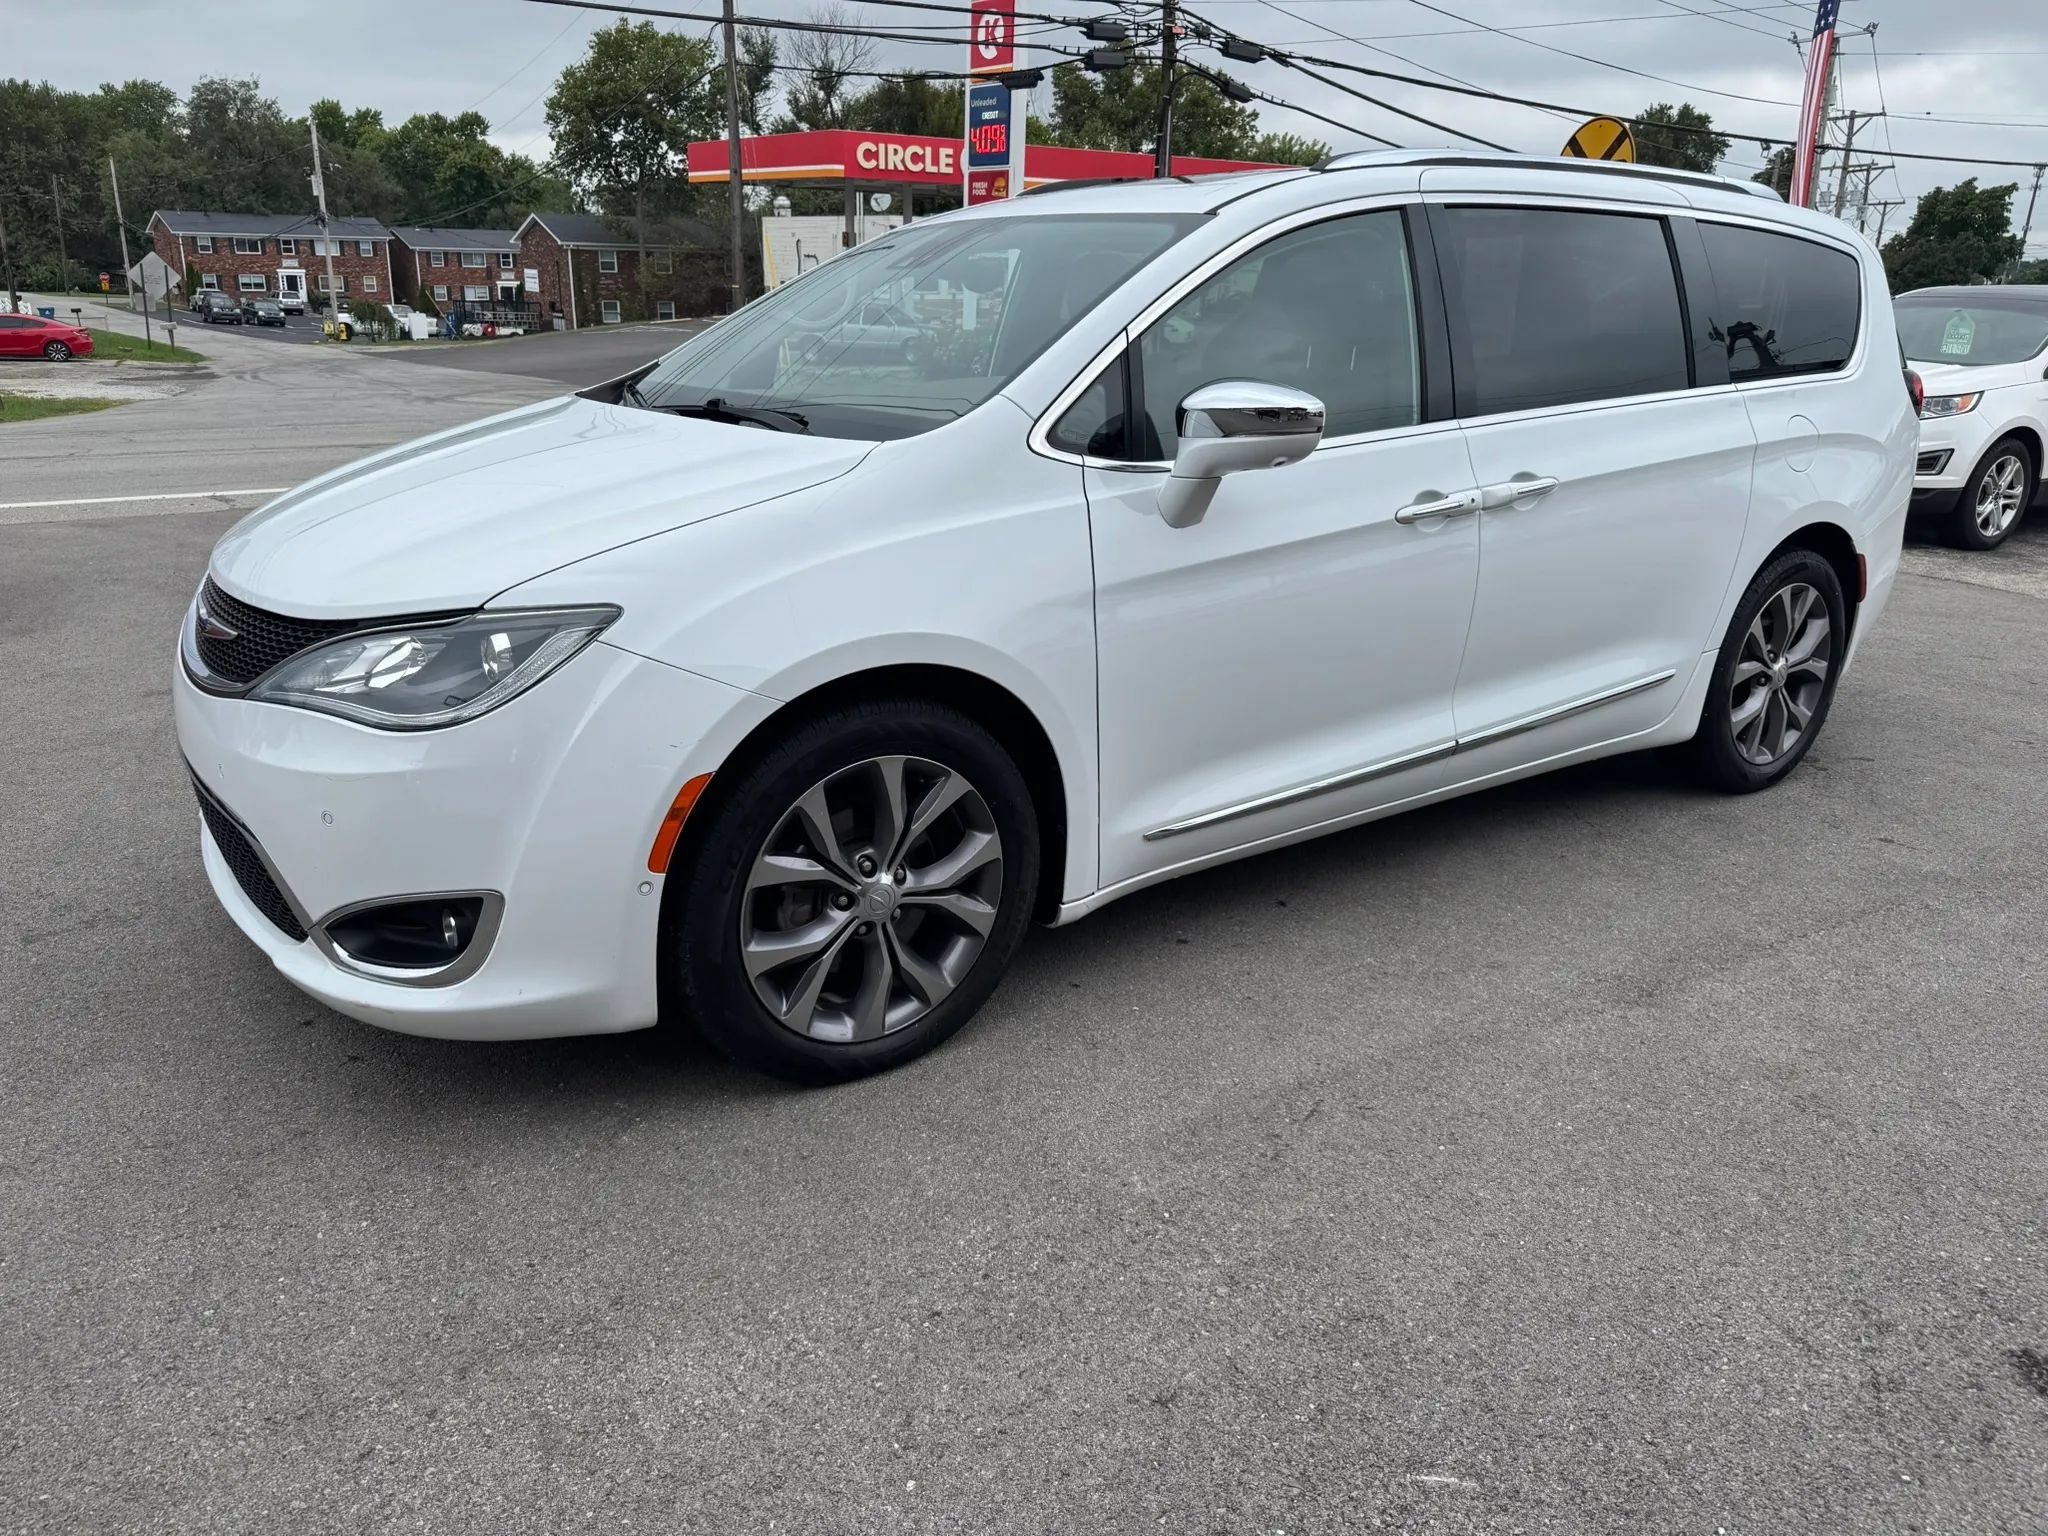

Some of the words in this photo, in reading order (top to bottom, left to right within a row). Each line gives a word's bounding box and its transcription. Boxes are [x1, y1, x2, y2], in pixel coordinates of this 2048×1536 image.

[971, 96, 997, 108] Unleaded
[981, 110, 999, 120] CREDIT
[856, 141, 954, 174] CIRCLE
